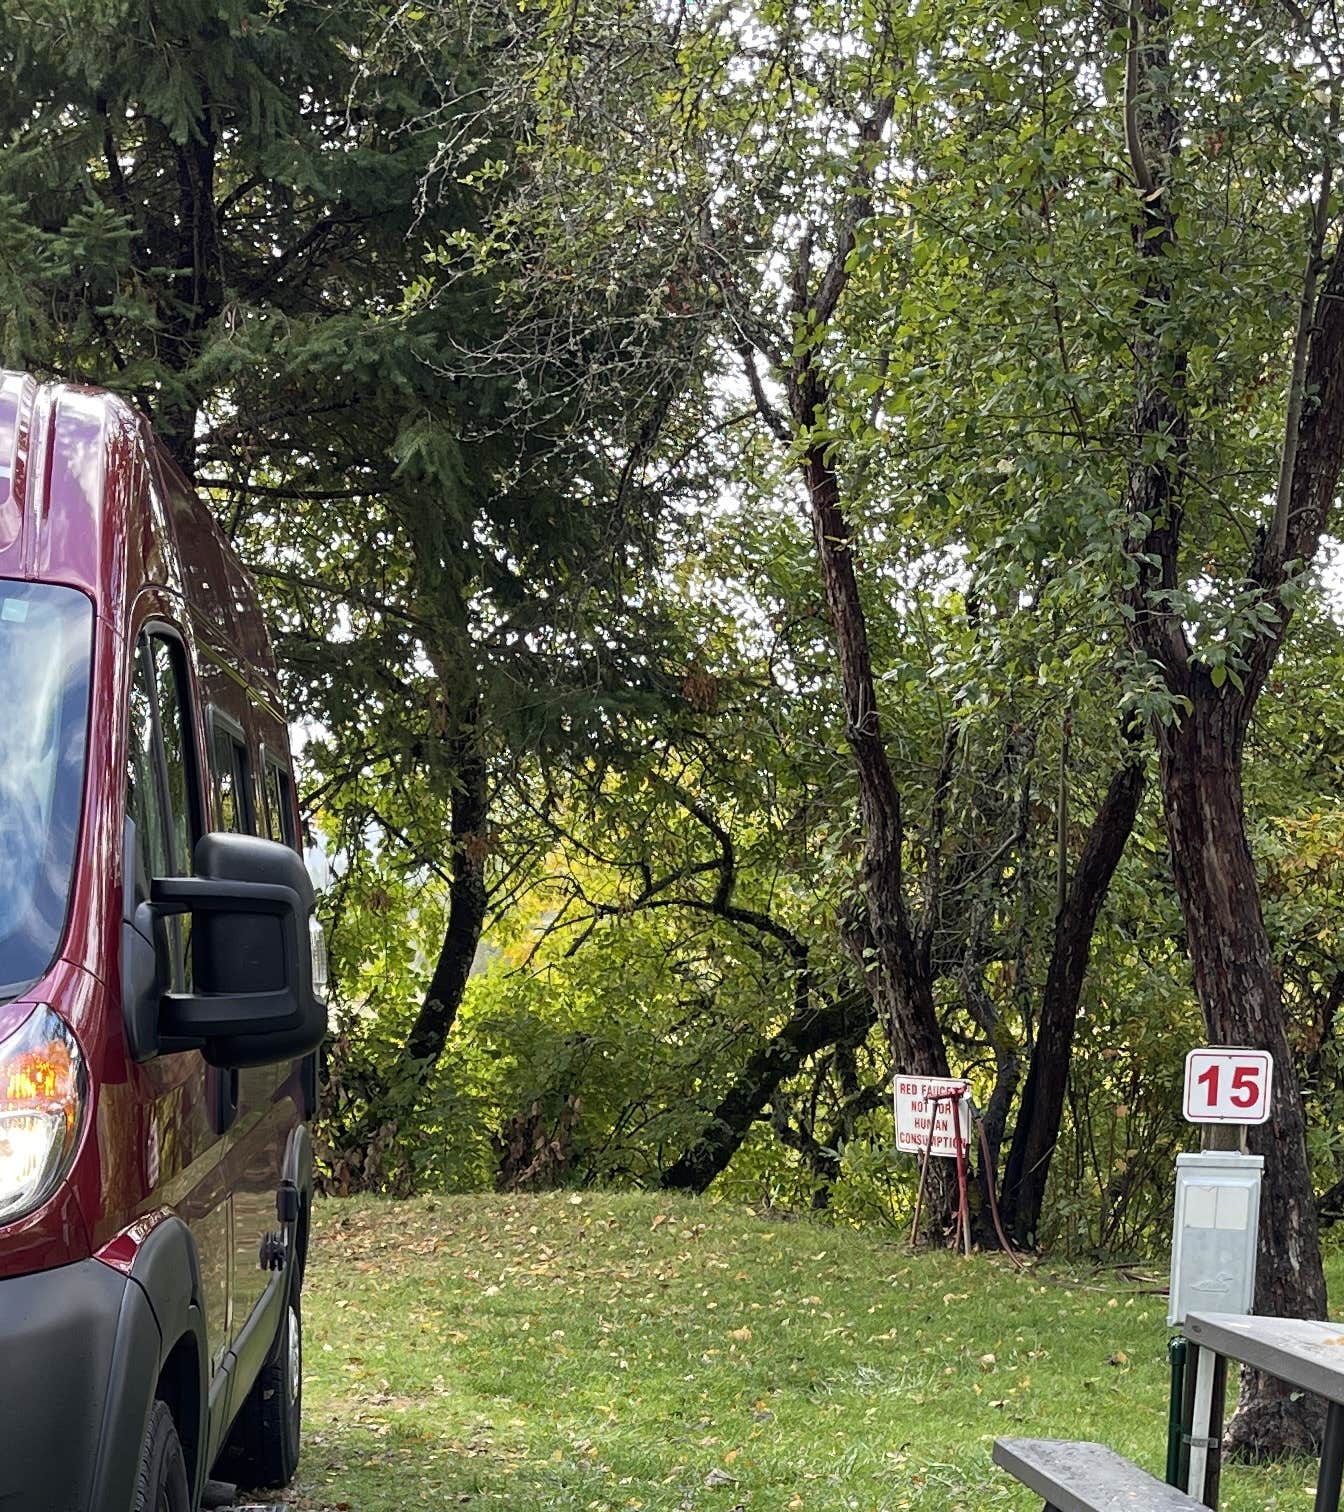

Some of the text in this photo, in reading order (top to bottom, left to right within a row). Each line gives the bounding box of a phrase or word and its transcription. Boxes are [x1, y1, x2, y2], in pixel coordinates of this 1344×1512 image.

[900, 1083, 917, 1095] RED
[1197, 1065, 1259, 1108] 15
[911, 1101, 951, 1115] NOT OR
